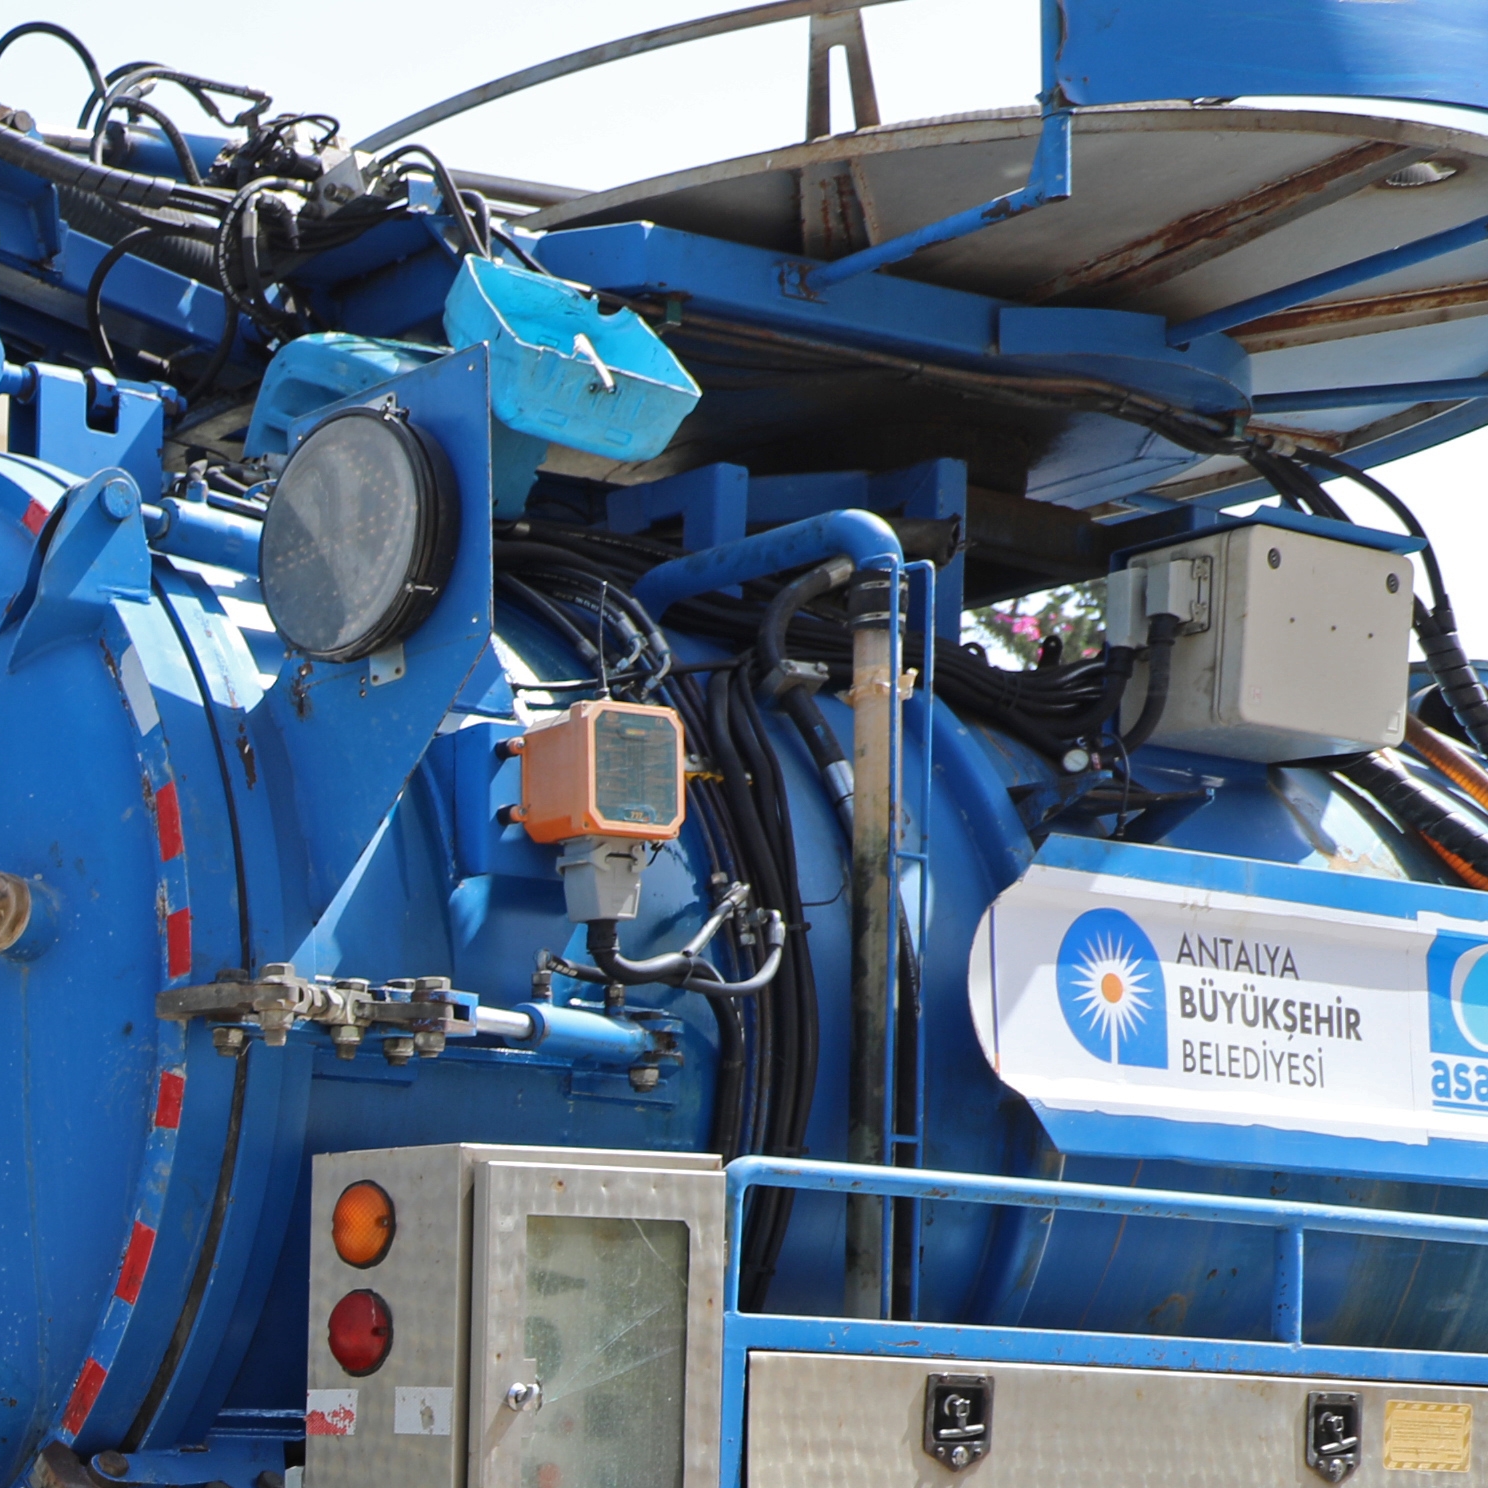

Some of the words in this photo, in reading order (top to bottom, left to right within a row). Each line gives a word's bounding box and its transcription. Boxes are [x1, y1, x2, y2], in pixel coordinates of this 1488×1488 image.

[1176, 932, 1300, 981] ANTALYA
[1179, 979, 1363, 1043] BÜYÜKŞEHİR
[1182, 1039, 1325, 1089] BELEDİYESİ
